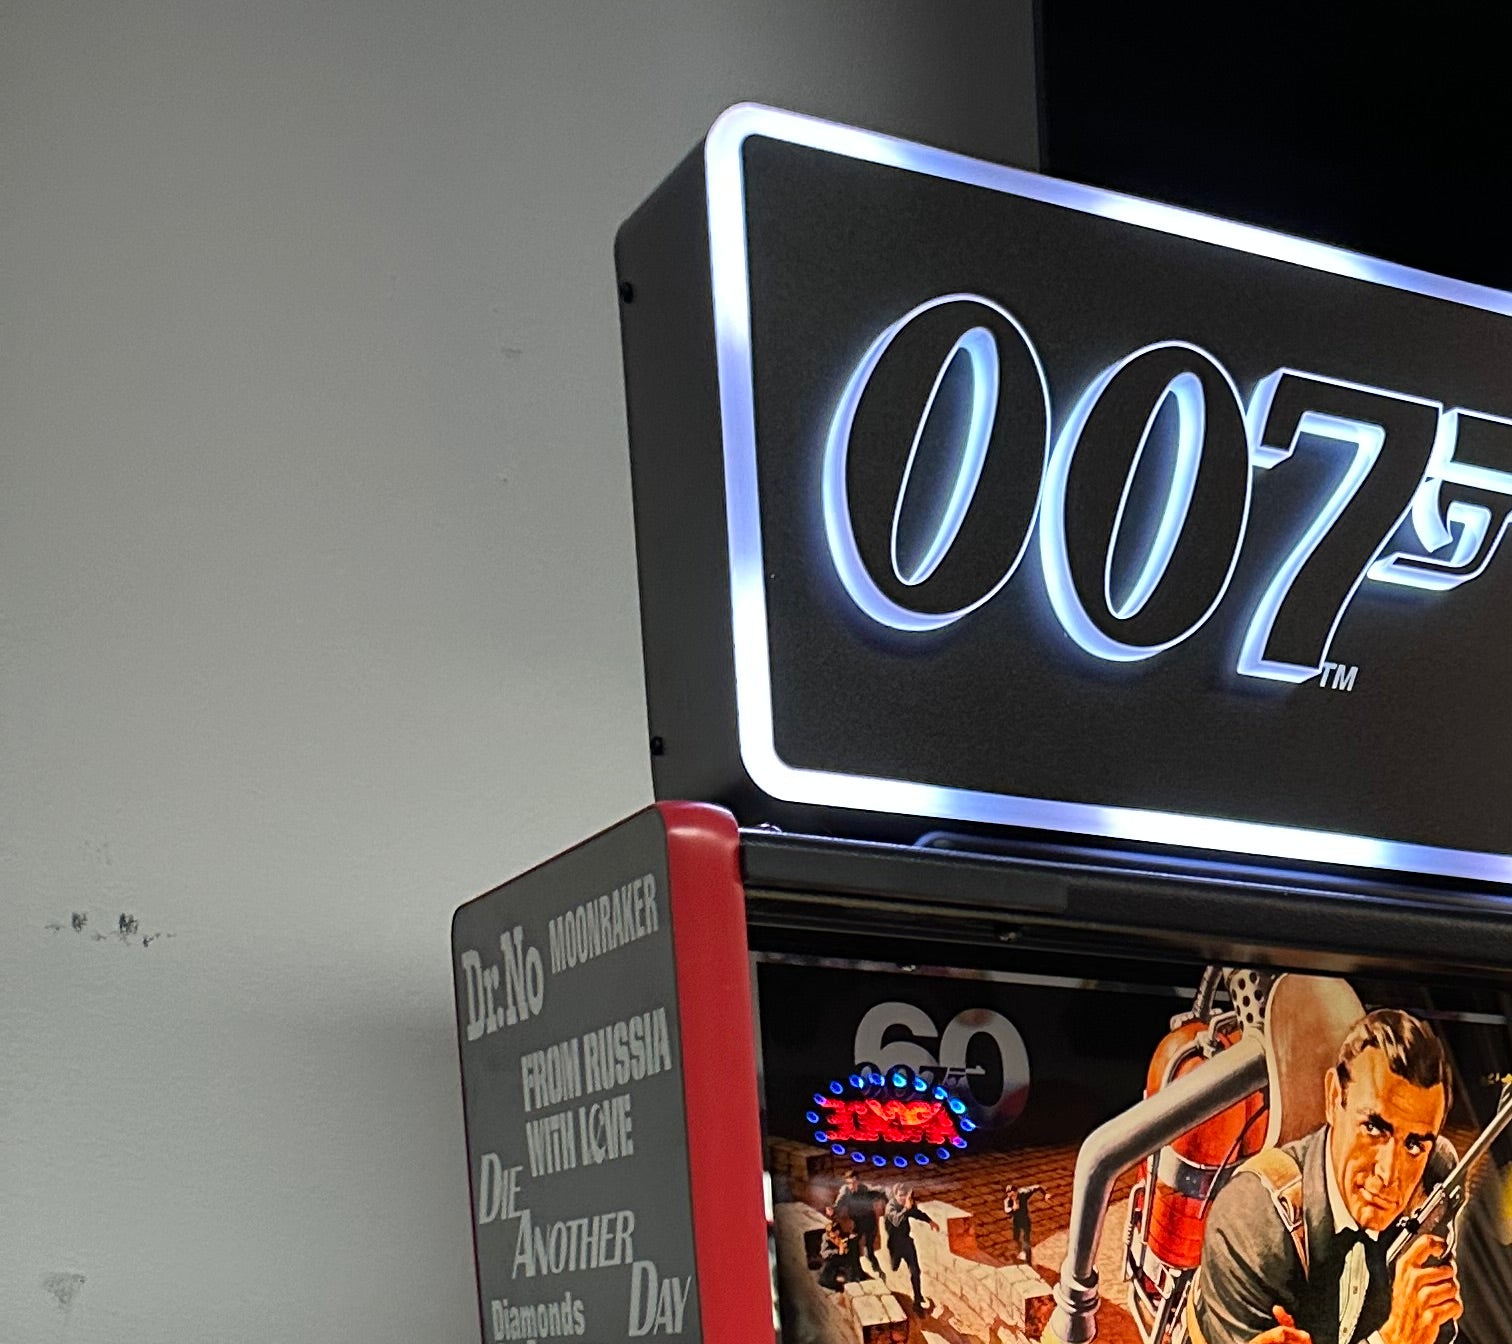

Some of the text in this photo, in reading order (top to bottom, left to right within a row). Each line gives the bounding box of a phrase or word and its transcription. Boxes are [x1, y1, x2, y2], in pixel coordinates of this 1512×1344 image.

[824, 293, 1444, 685] 007
[1318, 661, 1358, 692] TM
[548, 872, 659, 974] MOONRAKER
[520, 1007, 673, 1112] FROM RUSSIA
[526, 1093, 635, 1177] WITH LOVE
[479, 1152, 524, 1225] DIE
[512, 1209, 635, 1280] ANOTHER
[492, 1291, 586, 1341] Diamonds
[628, 1259, 691, 1339] DAY
